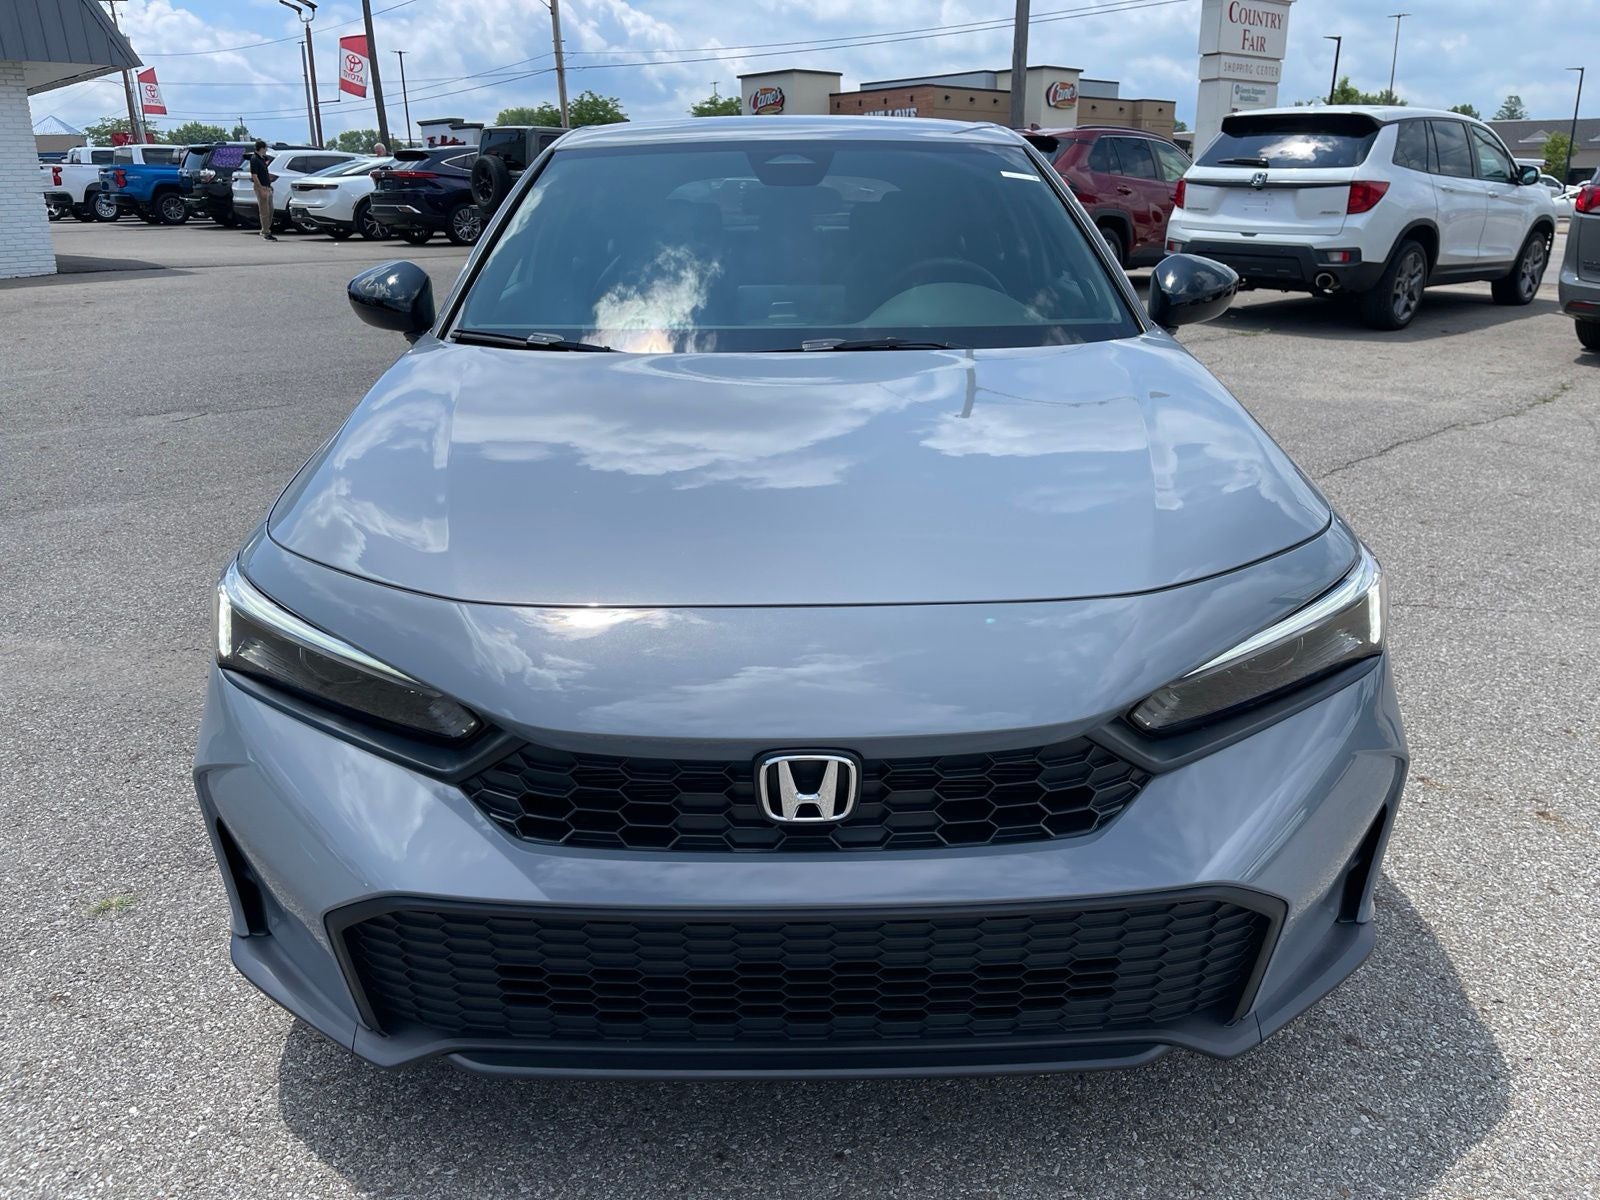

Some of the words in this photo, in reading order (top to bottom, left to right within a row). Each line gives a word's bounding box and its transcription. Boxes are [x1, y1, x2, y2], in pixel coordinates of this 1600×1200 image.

[1228, 1, 1284, 29] COUNTRY
[1241, 28, 1266, 52] FAIR
[343, 69, 364, 84] TOYOTA
